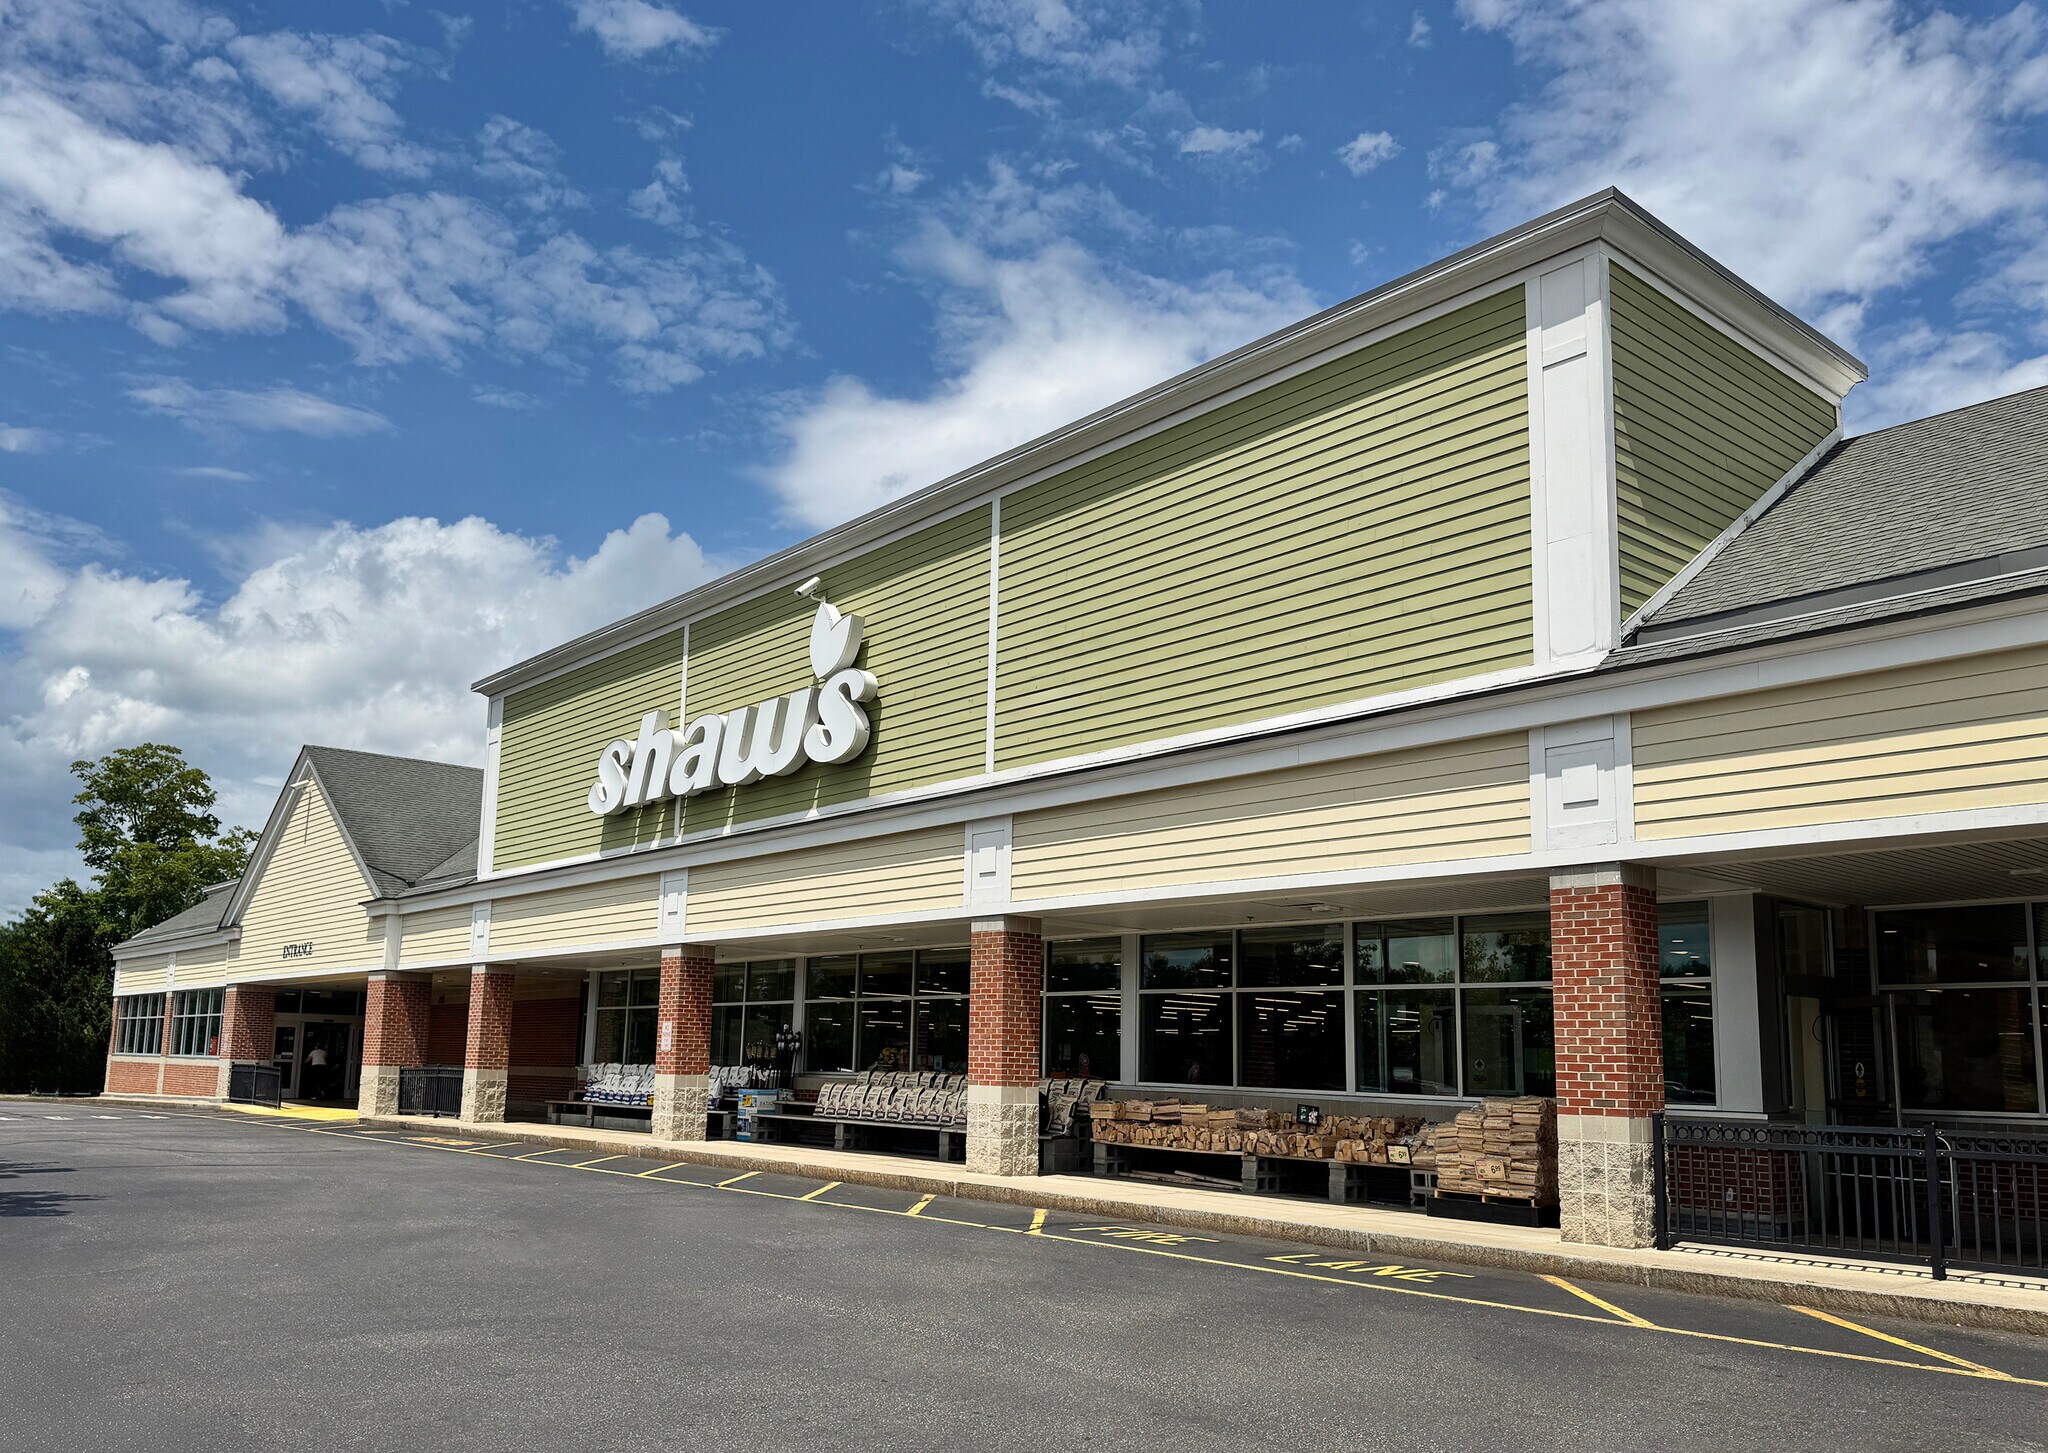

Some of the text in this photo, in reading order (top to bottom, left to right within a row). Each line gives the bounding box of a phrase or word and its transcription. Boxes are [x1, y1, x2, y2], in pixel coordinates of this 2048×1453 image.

[282, 941, 314, 959] ENTRANCE
[1068, 1226, 1476, 1283] FIRE LANE
